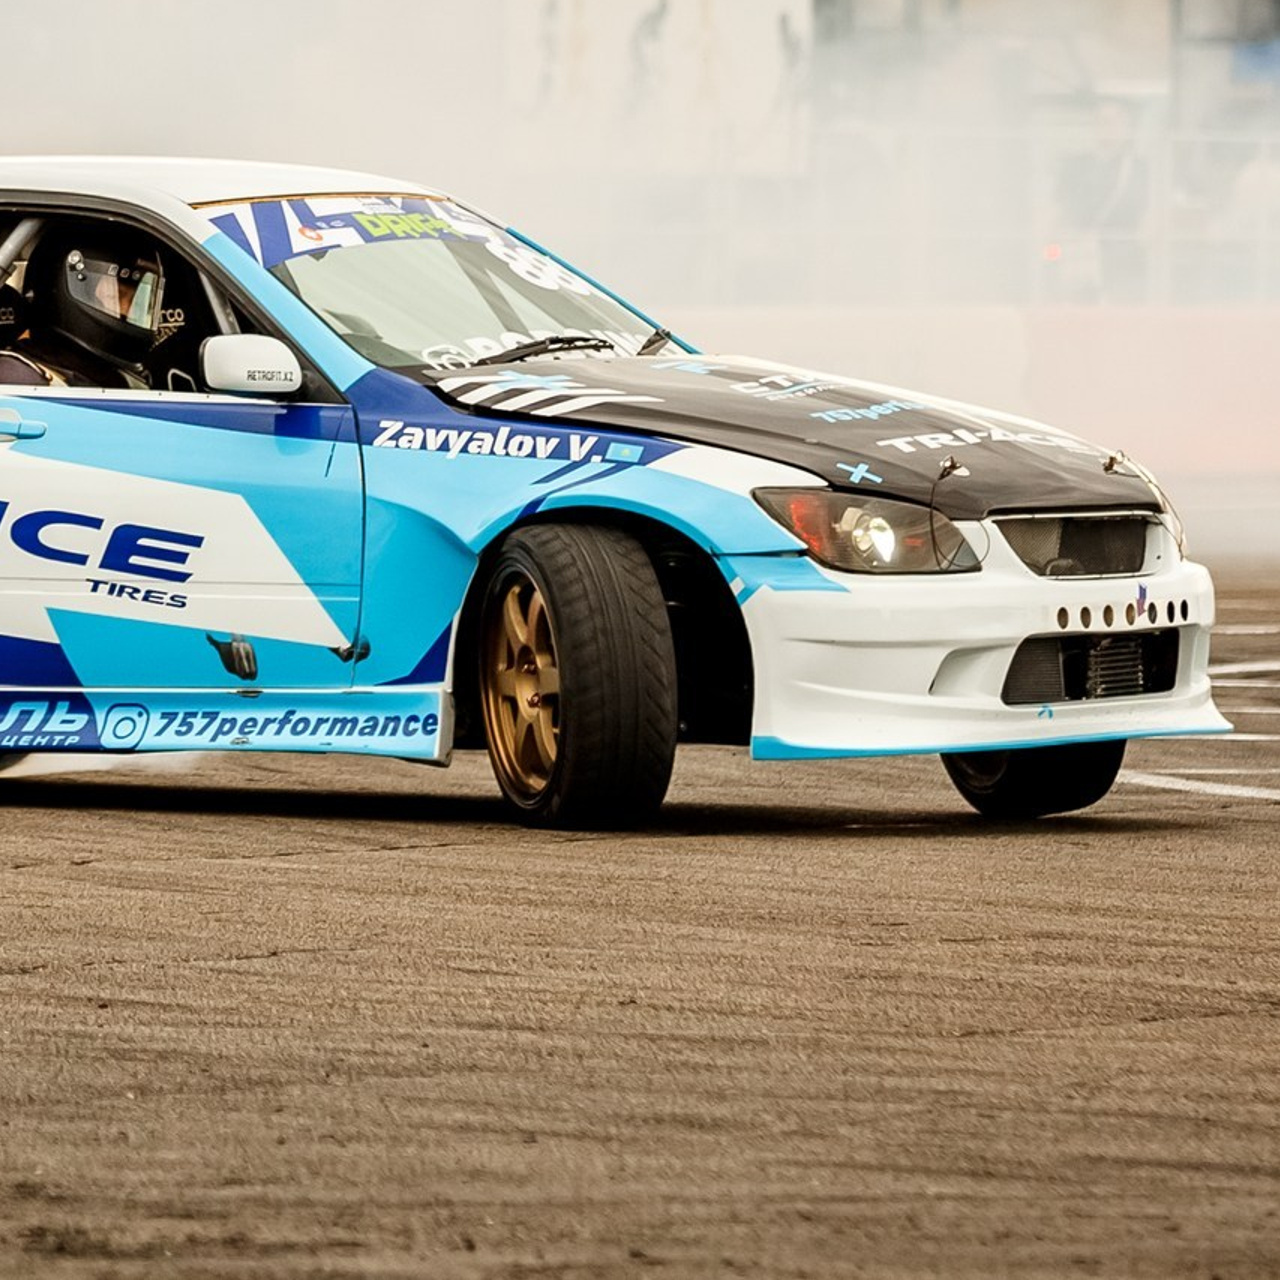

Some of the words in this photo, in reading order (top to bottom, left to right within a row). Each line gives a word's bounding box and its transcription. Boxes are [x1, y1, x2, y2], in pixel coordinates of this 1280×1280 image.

[373, 420, 559, 459] Zavyalov
[570, 434, 602, 463] V.
[85, 578, 188, 608] TIRES
[154, 709, 438, 742] 757performance
